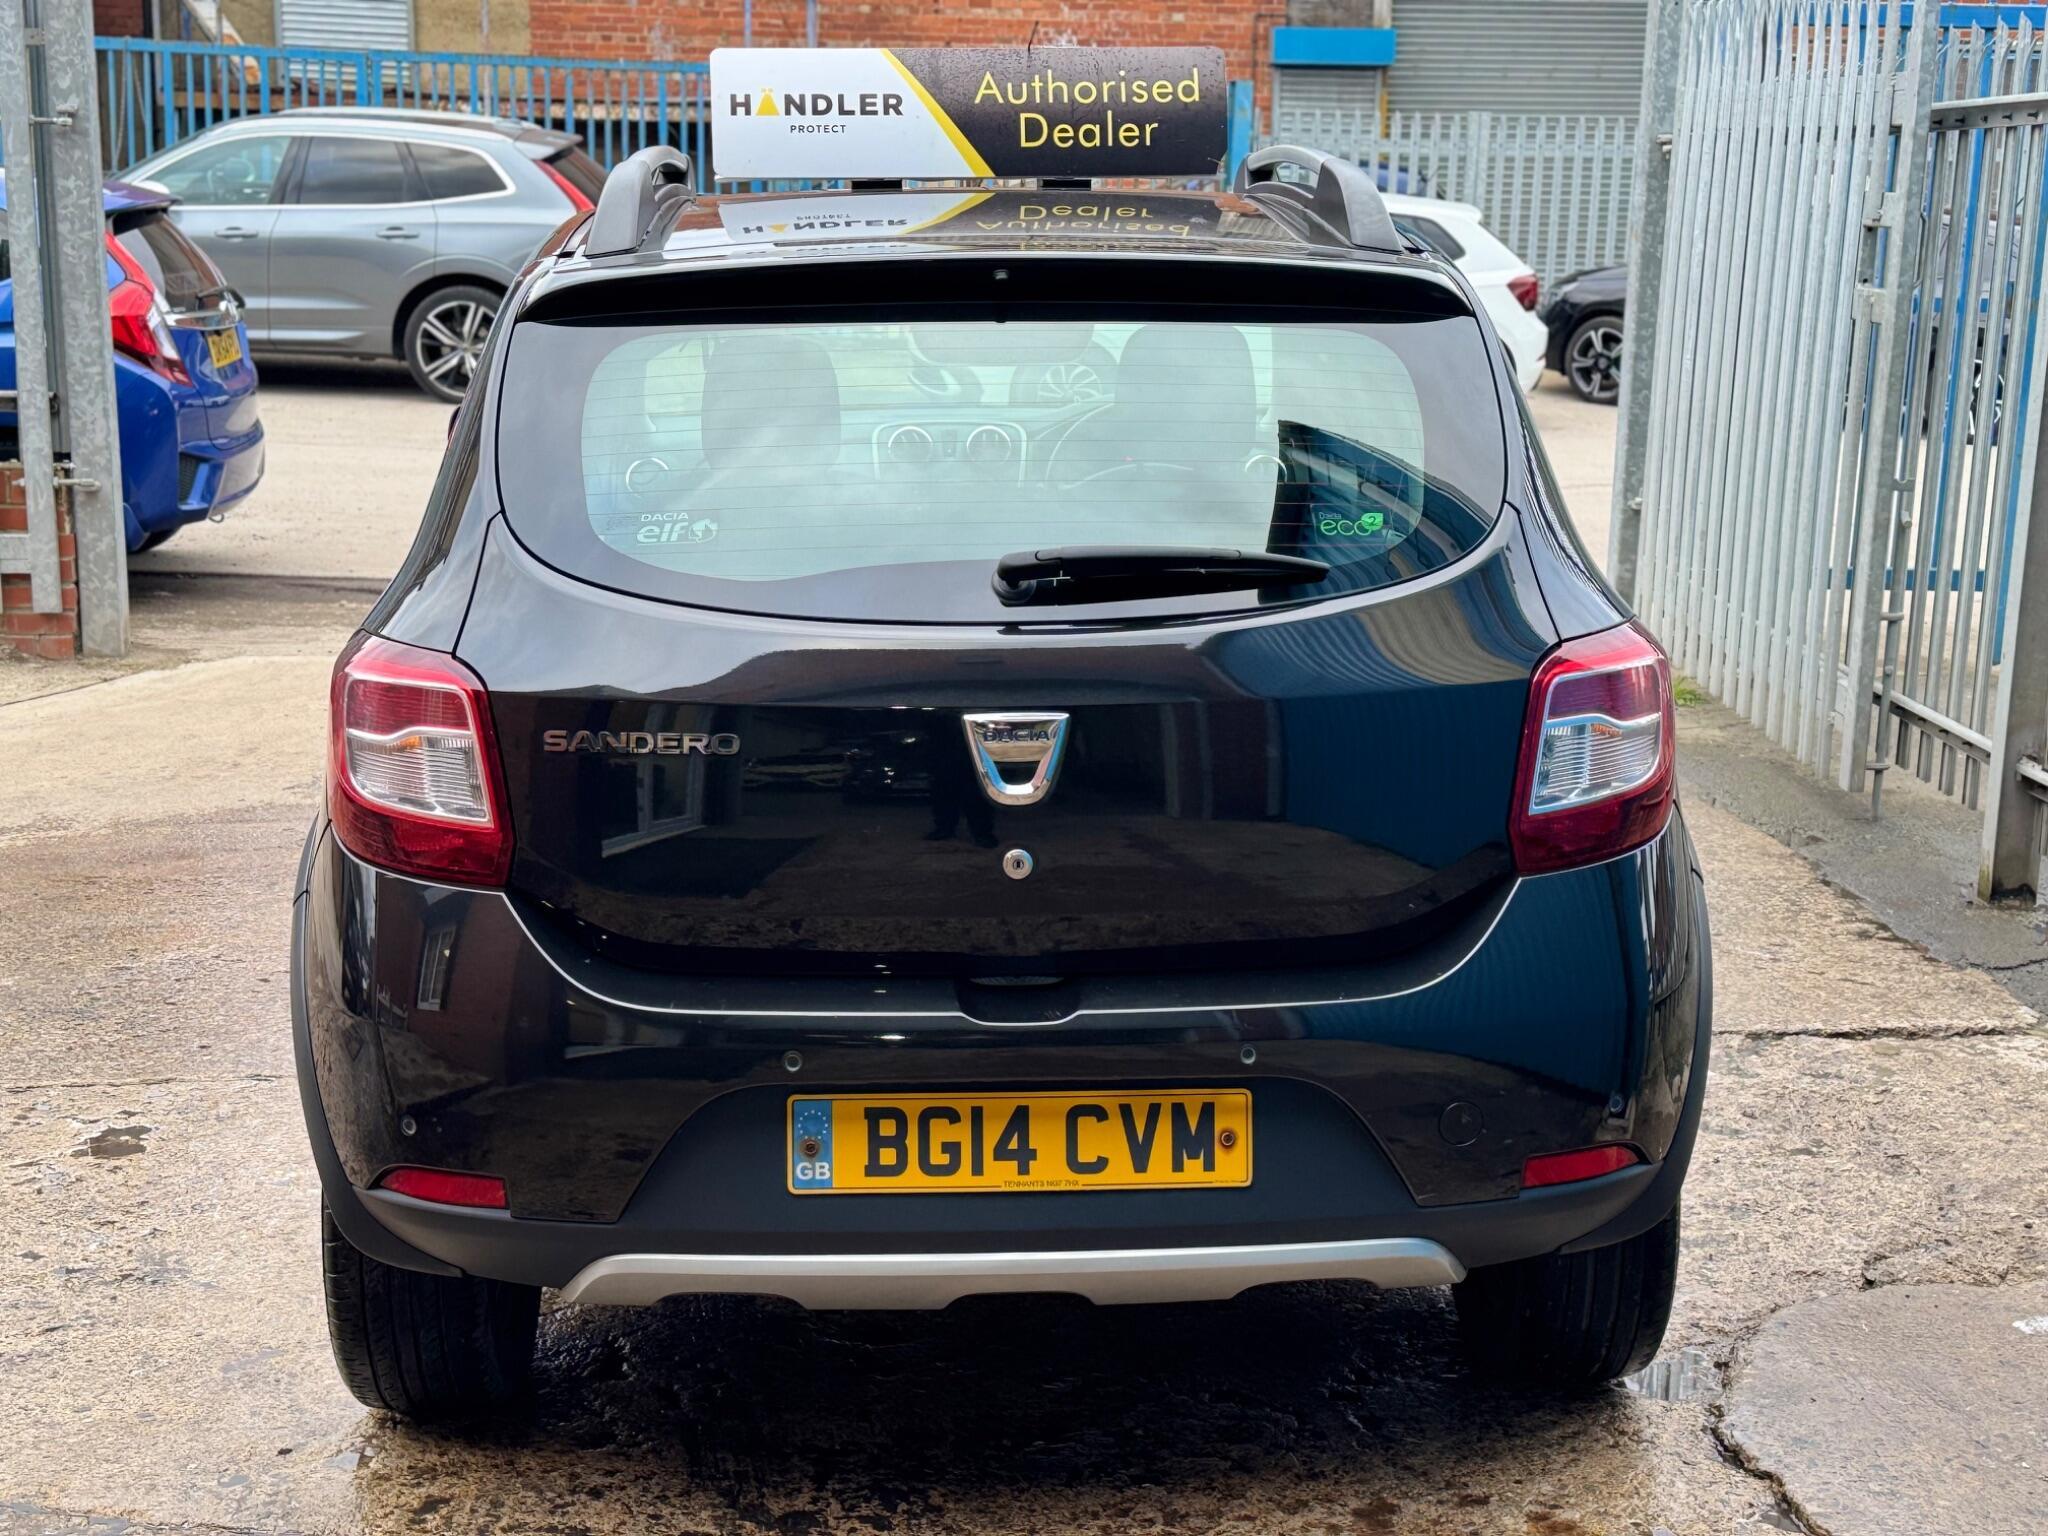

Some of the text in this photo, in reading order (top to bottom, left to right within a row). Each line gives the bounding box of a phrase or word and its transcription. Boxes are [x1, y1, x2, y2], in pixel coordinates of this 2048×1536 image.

[974, 67, 1200, 105] Authorised
[790, 124, 846, 134] PROTECT
[1019, 110, 1159, 148] Dealer
[640, 512, 689, 522] DACIA
[636, 522, 689, 543] elf
[543, 729, 741, 755] SANDERO
[983, 729, 1050, 742] DACIA
[863, 1101, 1216, 1178] BG14 CVM
[796, 1162, 831, 1180] GB
[1004, 1180, 1045, 1188] TENNANTS
